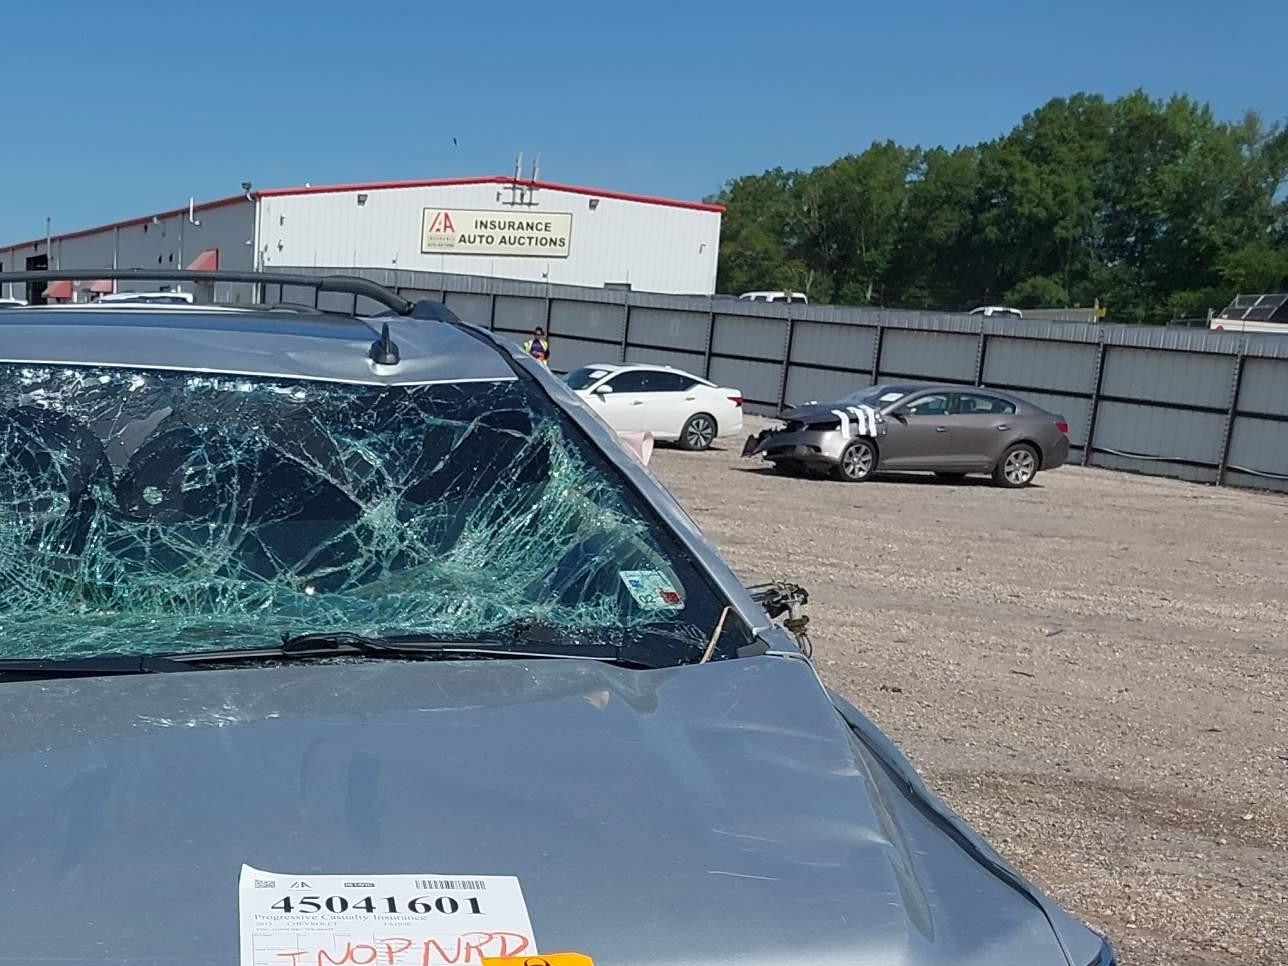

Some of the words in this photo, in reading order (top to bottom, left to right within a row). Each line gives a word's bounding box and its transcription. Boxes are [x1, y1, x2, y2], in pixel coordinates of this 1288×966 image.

[474, 219, 552, 232] INSURANCE
[458, 234, 494, 245] AUTO
[498, 235, 566, 247] AUCTIONS
[271, 895, 485, 915] 45041601
